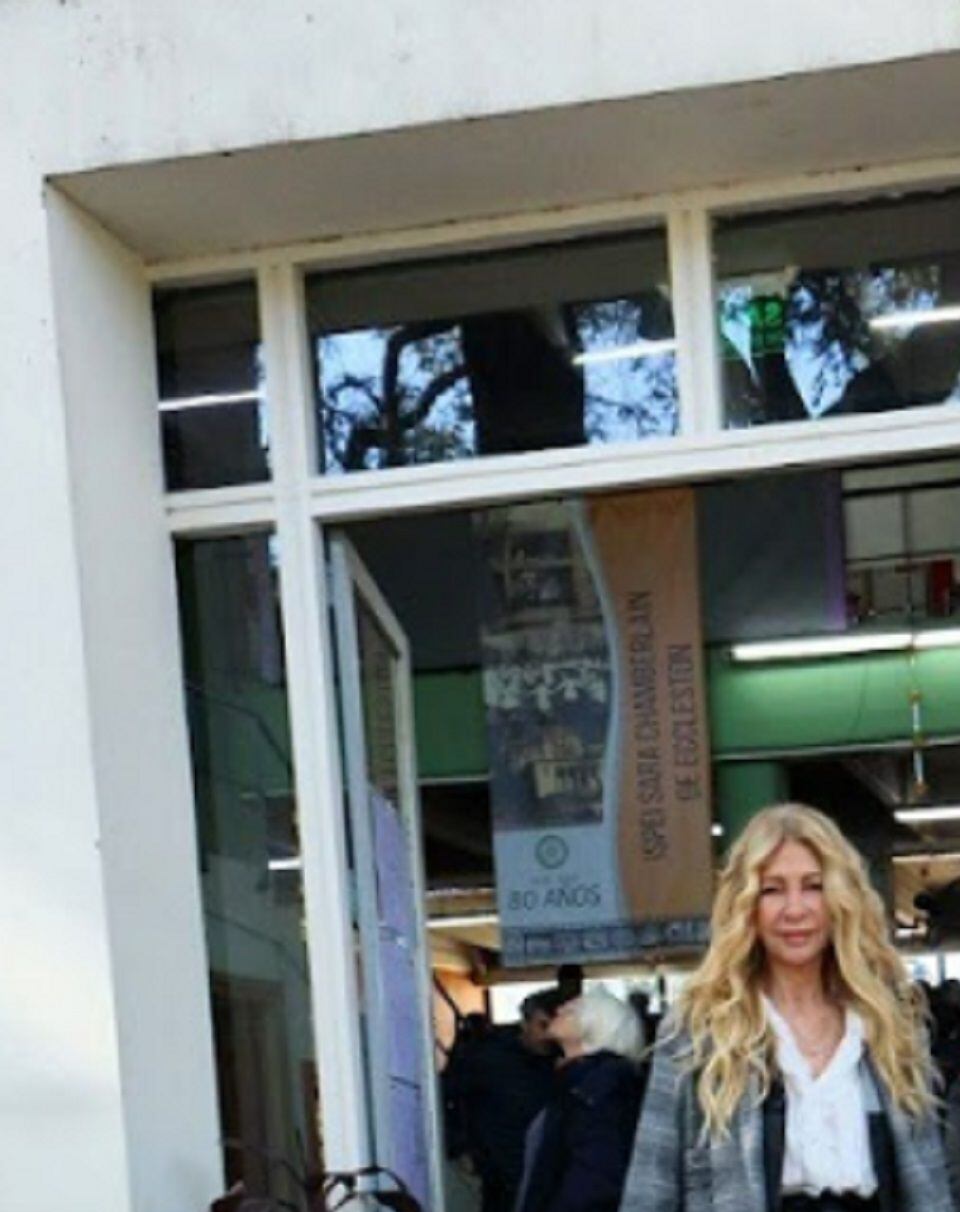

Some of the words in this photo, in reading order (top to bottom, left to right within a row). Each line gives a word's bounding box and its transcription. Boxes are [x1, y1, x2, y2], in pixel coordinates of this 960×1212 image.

[627, 591, 660, 744] CHAMBERLAIN
[668, 643, 698, 767] ECCLESTON
[636, 749, 662, 805] SARA
[675, 777, 699, 802] DE
[508, 889, 537, 911] 80
